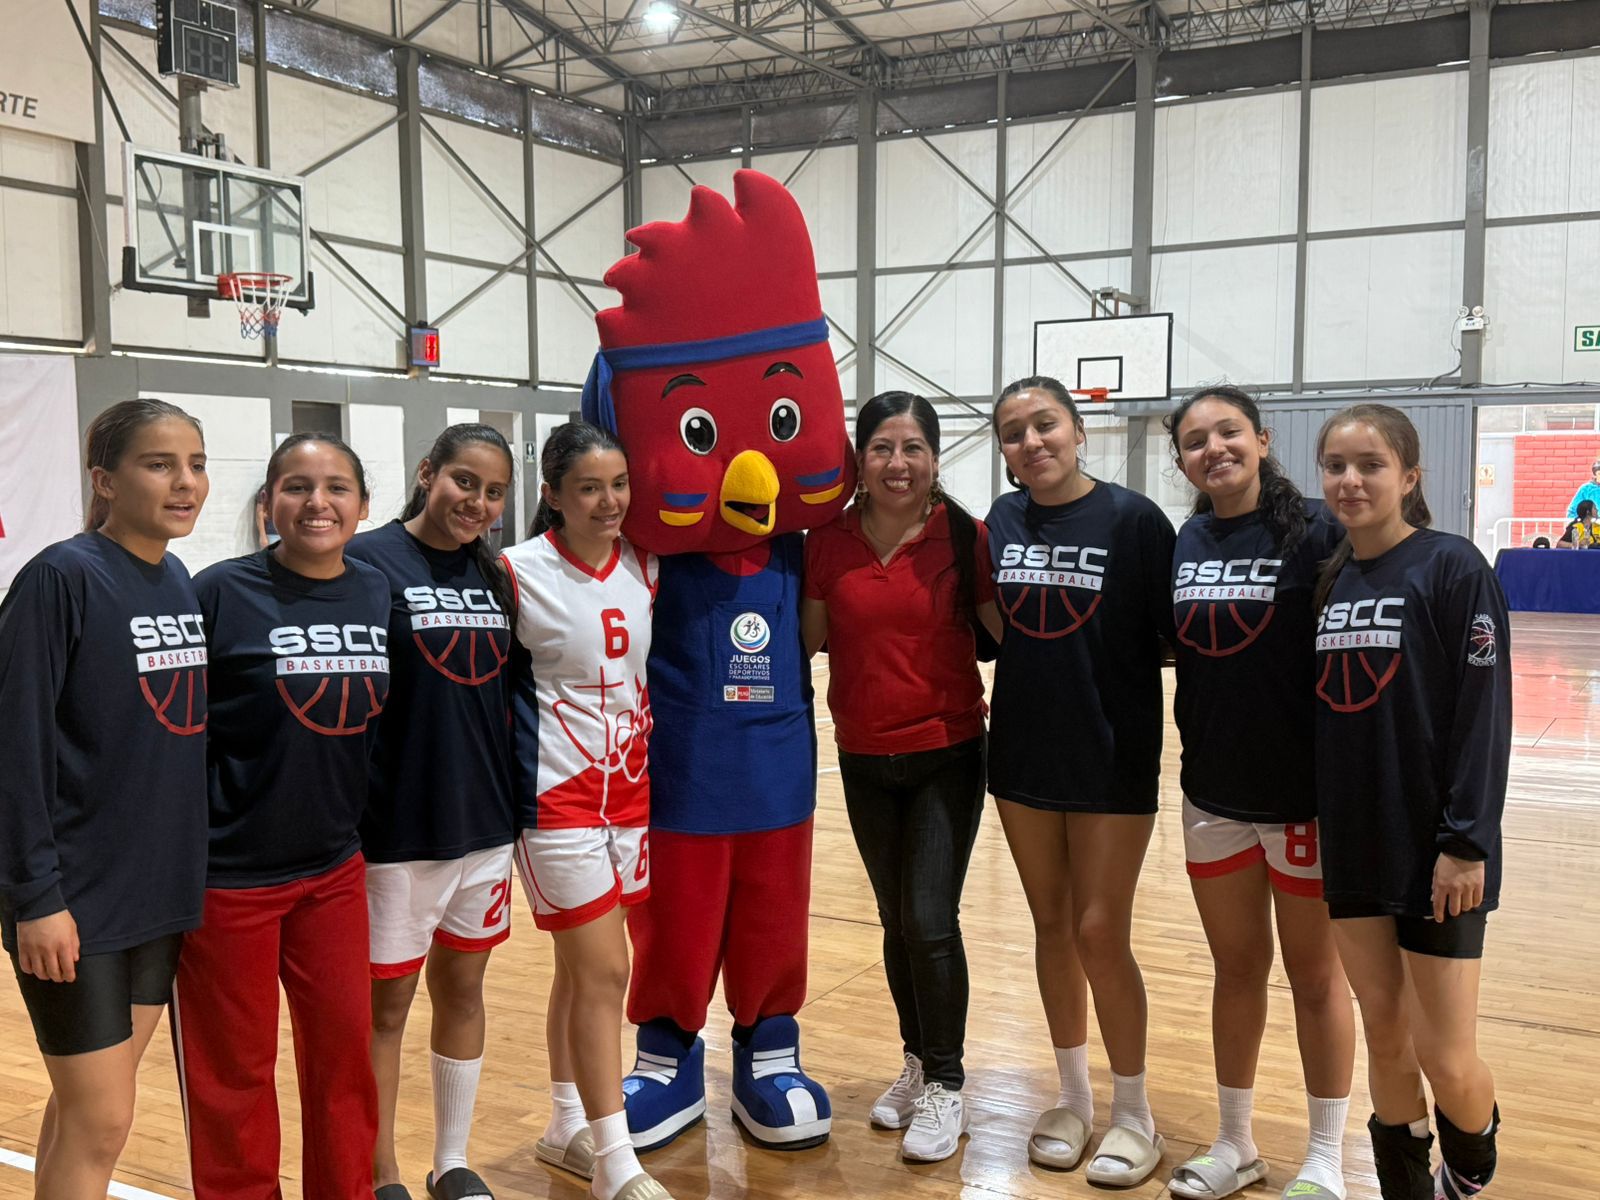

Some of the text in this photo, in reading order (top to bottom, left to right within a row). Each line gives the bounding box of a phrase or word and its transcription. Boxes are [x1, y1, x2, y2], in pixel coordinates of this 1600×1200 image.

[1000, 543, 1109, 574] SSCC
[1175, 558, 1283, 587] SSCC
[1002, 571, 1097, 588] BASKETBALL
[1176, 587, 1269, 600] BASKETBALL
[600, 607, 630, 660] 6
[730, 654, 771, 664] JUEGOS
[1284, 820, 1318, 867] 8
